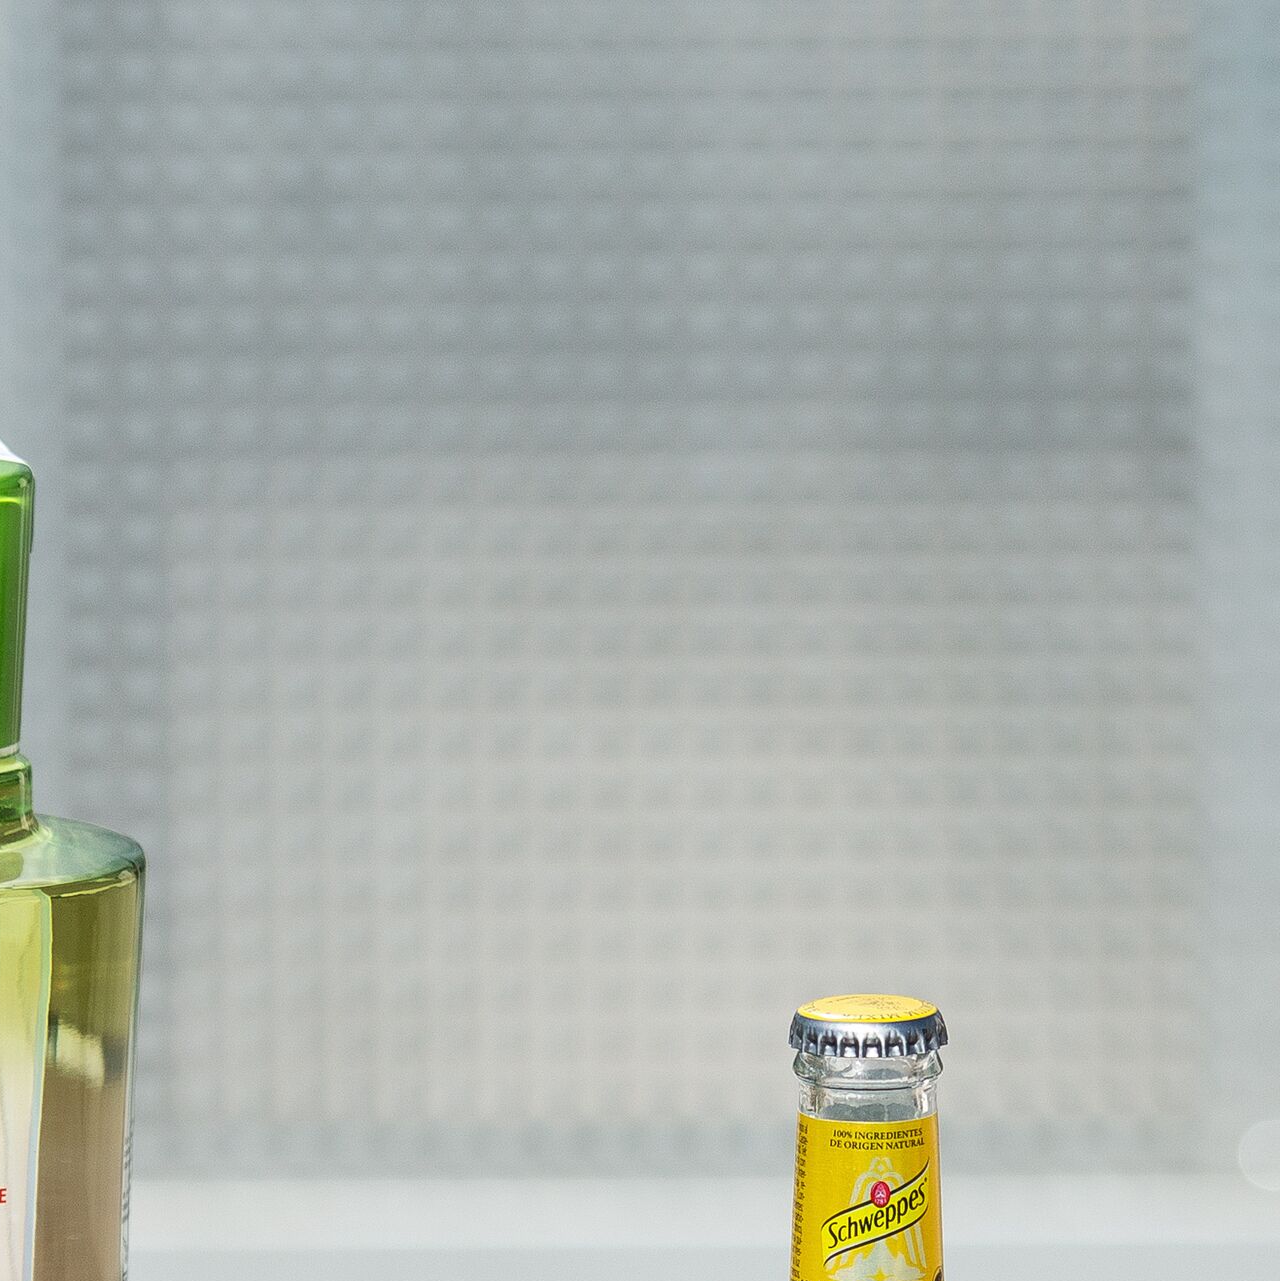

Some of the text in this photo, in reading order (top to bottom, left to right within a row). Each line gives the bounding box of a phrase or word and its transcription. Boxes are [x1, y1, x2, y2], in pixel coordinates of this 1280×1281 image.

[832, 1128, 924, 1141] 100% INGREDIENTES
[829, 1138, 925, 1151] DE ORIGEN NATURAL
[827, 1182, 926, 1250] Schweppes
